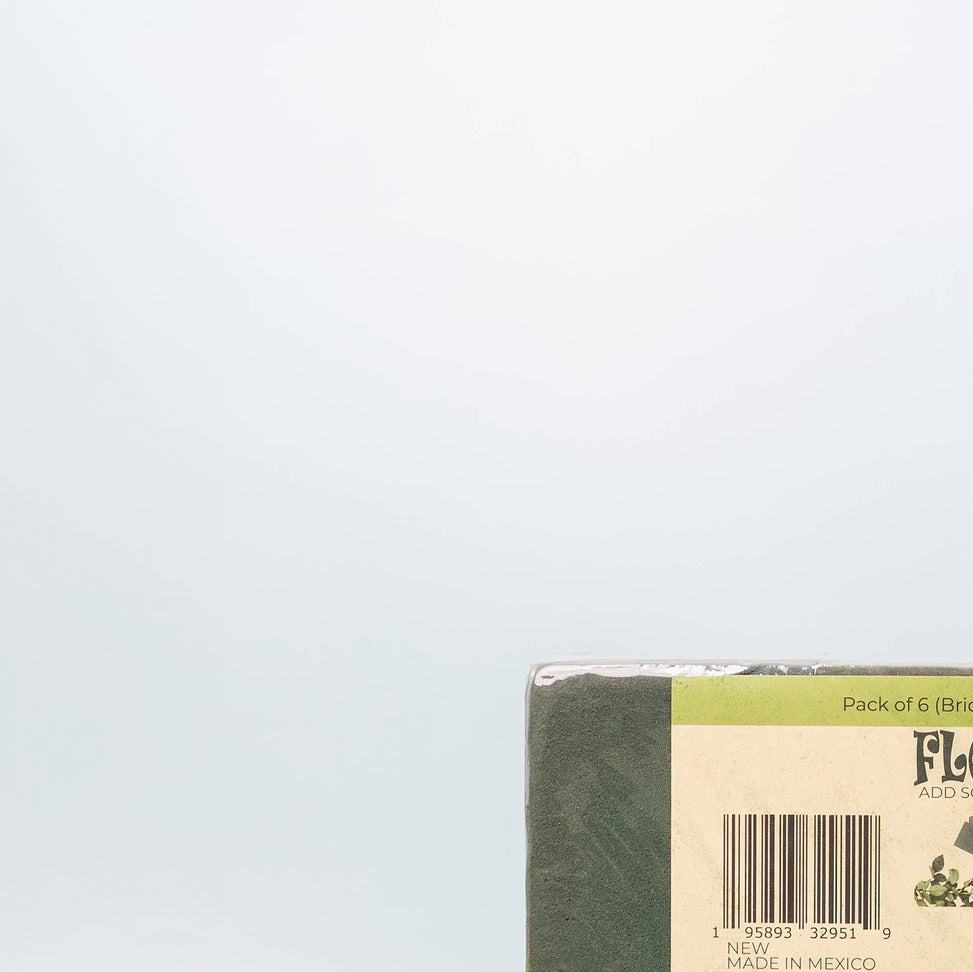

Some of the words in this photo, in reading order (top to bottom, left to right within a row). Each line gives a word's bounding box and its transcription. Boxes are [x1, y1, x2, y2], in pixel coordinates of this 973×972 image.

[843, 697, 889, 713] Pack
[894, 697, 914, 713] of
[919, 697, 929, 713] 6
[918, 786, 957, 800] ADD
[712, 926, 720, 938] 1
[744, 926, 793, 939] 95893
[809, 927, 857, 939] 32951
[882, 927, 892, 940] 9
[727, 941, 770, 955] NEW
[727, 956, 780, 970] MADE
[785, 957, 802, 970] IN
[808, 957, 877, 971] MEXICO
